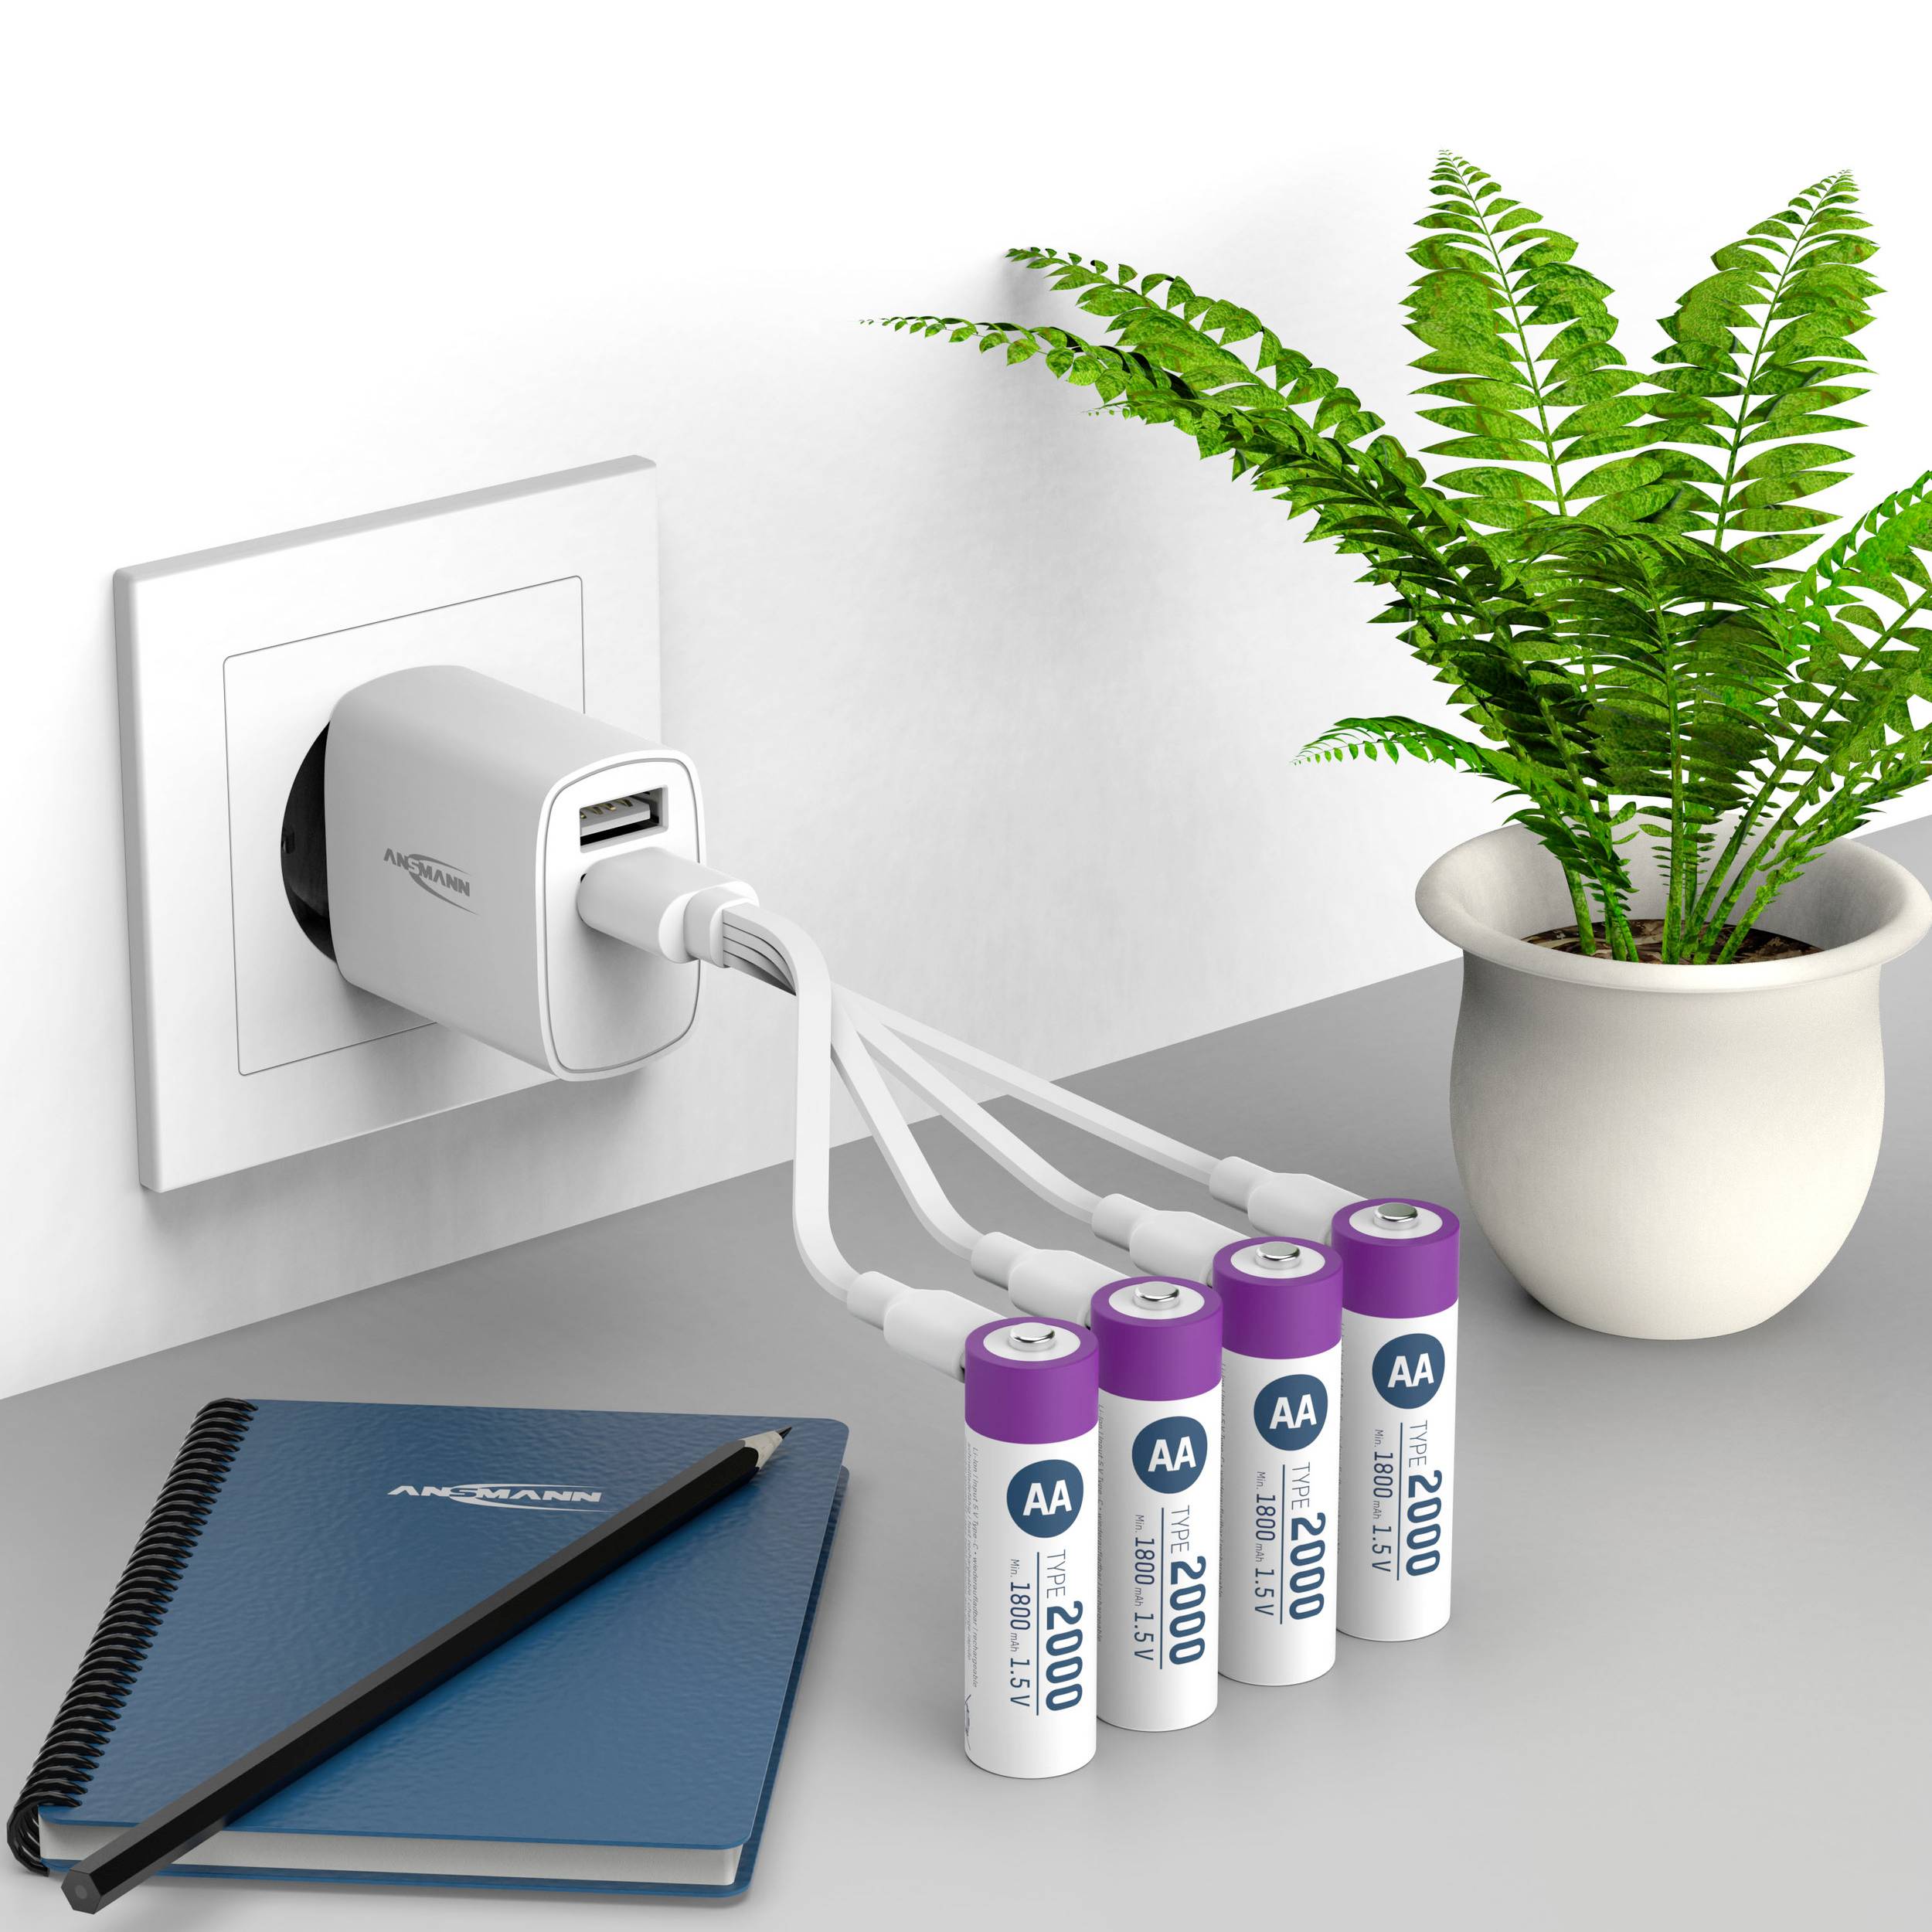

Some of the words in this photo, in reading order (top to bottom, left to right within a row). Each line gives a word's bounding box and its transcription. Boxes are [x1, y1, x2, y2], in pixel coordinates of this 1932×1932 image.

[383, 848, 470, 897] ANSMANN
[1387, 1352, 1434, 1389] AA
[1269, 1393, 1317, 1430] AA
[1148, 1435, 1196, 1472] AA
[1374, 1429, 1384, 1447] Min.
[1409, 1420, 1428, 1468] TYPE
[1256, 1471, 1267, 1489] Min.
[1291, 1461, 1311, 1511] TYPE
[1372, 1451, 1394, 1498] 1800
[387, 1485, 602, 1502] ANSMANN
[1022, 1479, 1072, 1516] AA
[1372, 1501, 1383, 1519] mAh
[1134, 1514, 1145, 1532] Min.
[1170, 1505, 1190, 1555] TYPE
[1255, 1494, 1277, 1542] 1800
[1406, 1470, 1443, 1577] 2000
[1255, 1543, 1265, 1563] mAh
[1372, 1525, 1393, 1555] 1.5
[1010, 1559, 1020, 1577] Min.
[1046, 1549, 1066, 1600] TYPE
[1134, 1537, 1155, 1586] 1800
[1289, 1512, 1327, 1621] 2000
[1372, 1560, 1392, 1572] V
[1134, 1587, 1145, 1607] mAh
[1254, 1568, 1275, 1598] 1.5
[1009, 1582, 1032, 1631] 1800
[1169, 1556, 1207, 1665] 2000
[1254, 1604, 1274, 1617] V
[1009, 1633, 1020, 1652] mAh
[1134, 1612, 1155, 1643] 1.5
[1045, 1600, 1084, 1712] 2000
[1134, 1648, 1155, 1661] V
[1009, 1658, 1031, 1689] 1.5
[1009, 1695, 1031, 1707] V
